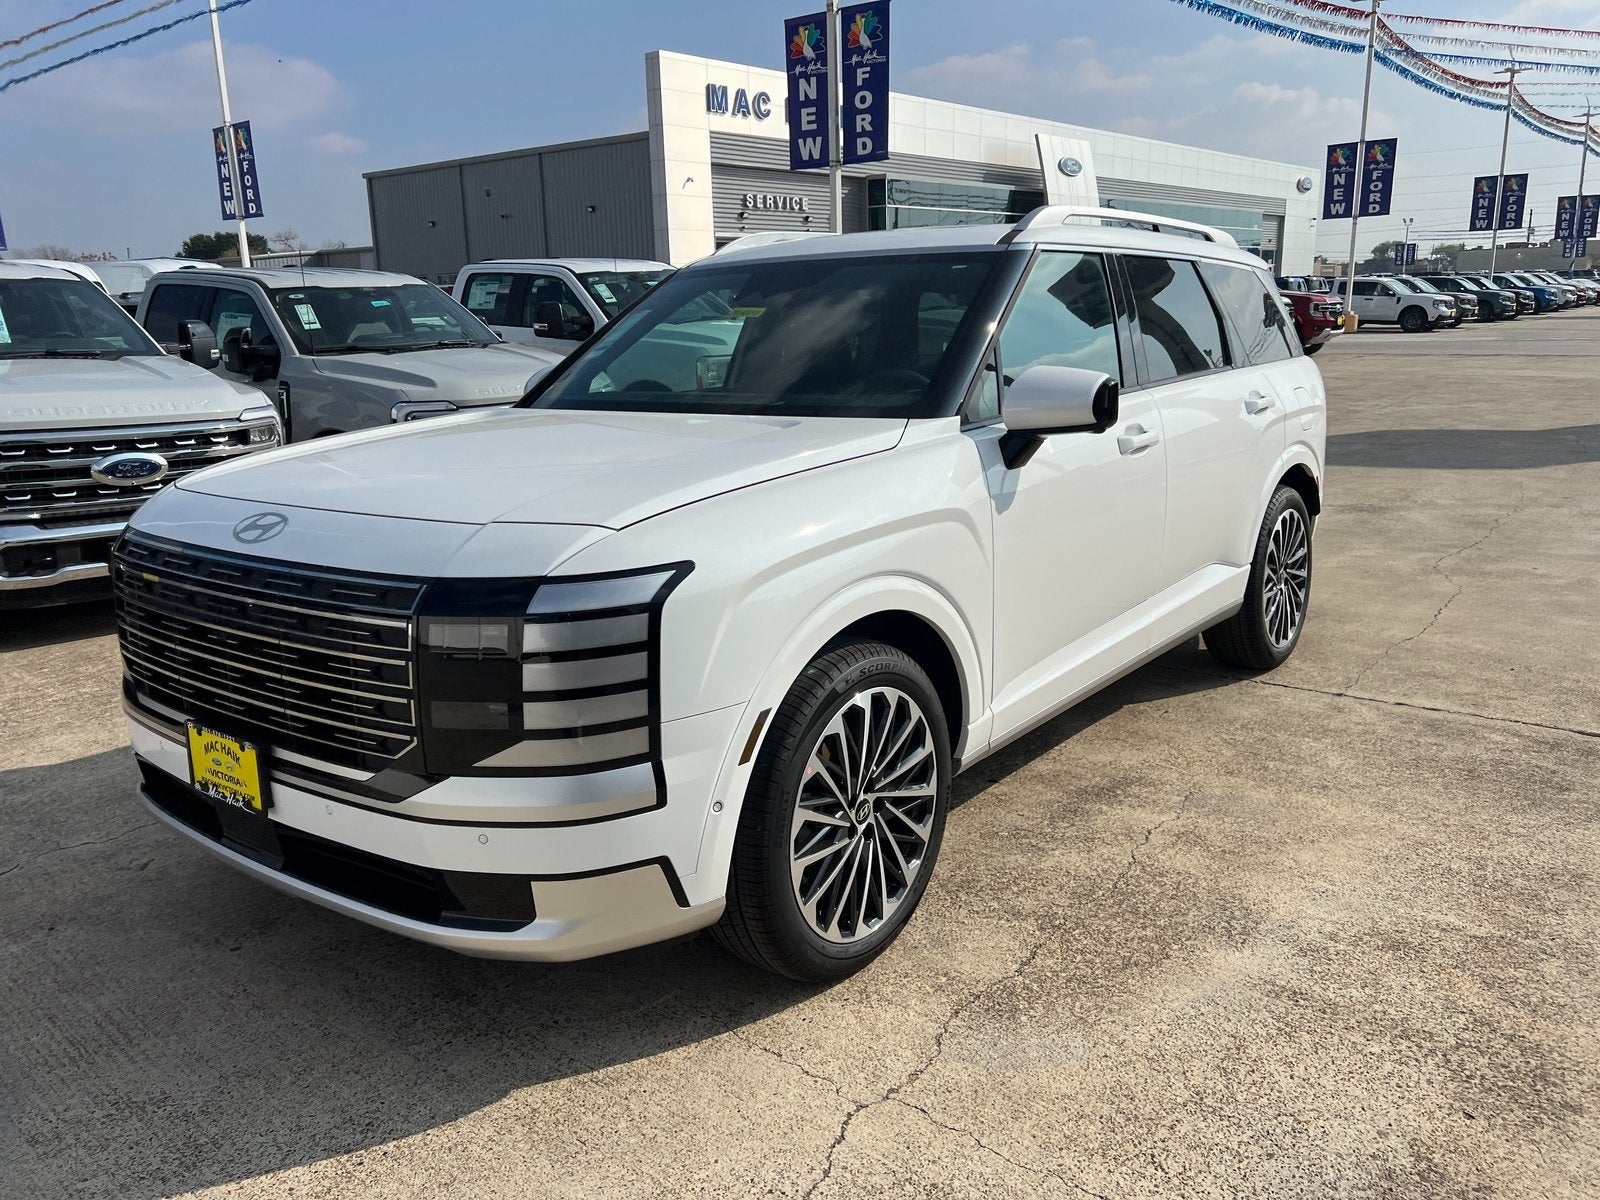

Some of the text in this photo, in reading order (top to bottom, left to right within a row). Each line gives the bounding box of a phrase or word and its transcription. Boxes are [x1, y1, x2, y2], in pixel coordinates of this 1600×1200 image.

[706, 83, 771, 120] MAC
[854, 66, 873, 156] FORD
[798, 77, 822, 160] NEW
[221, 163, 235, 215] NEW
[243, 161, 257, 214] FORD
[745, 193, 809, 211] SERVICE
[1330, 173, 1346, 215] NEW
[1368, 170, 1383, 213] FORD
[1475, 198, 1488, 229] NEW
[1505, 196, 1517, 228] FORD
[1559, 212, 1570, 237] NEW
[1583, 211, 1593, 236] FORD
[115, 461, 150, 477] Ford
[204, 740, 241, 768] MAC HAIK
[208, 784, 247, 808] Mac Haik
